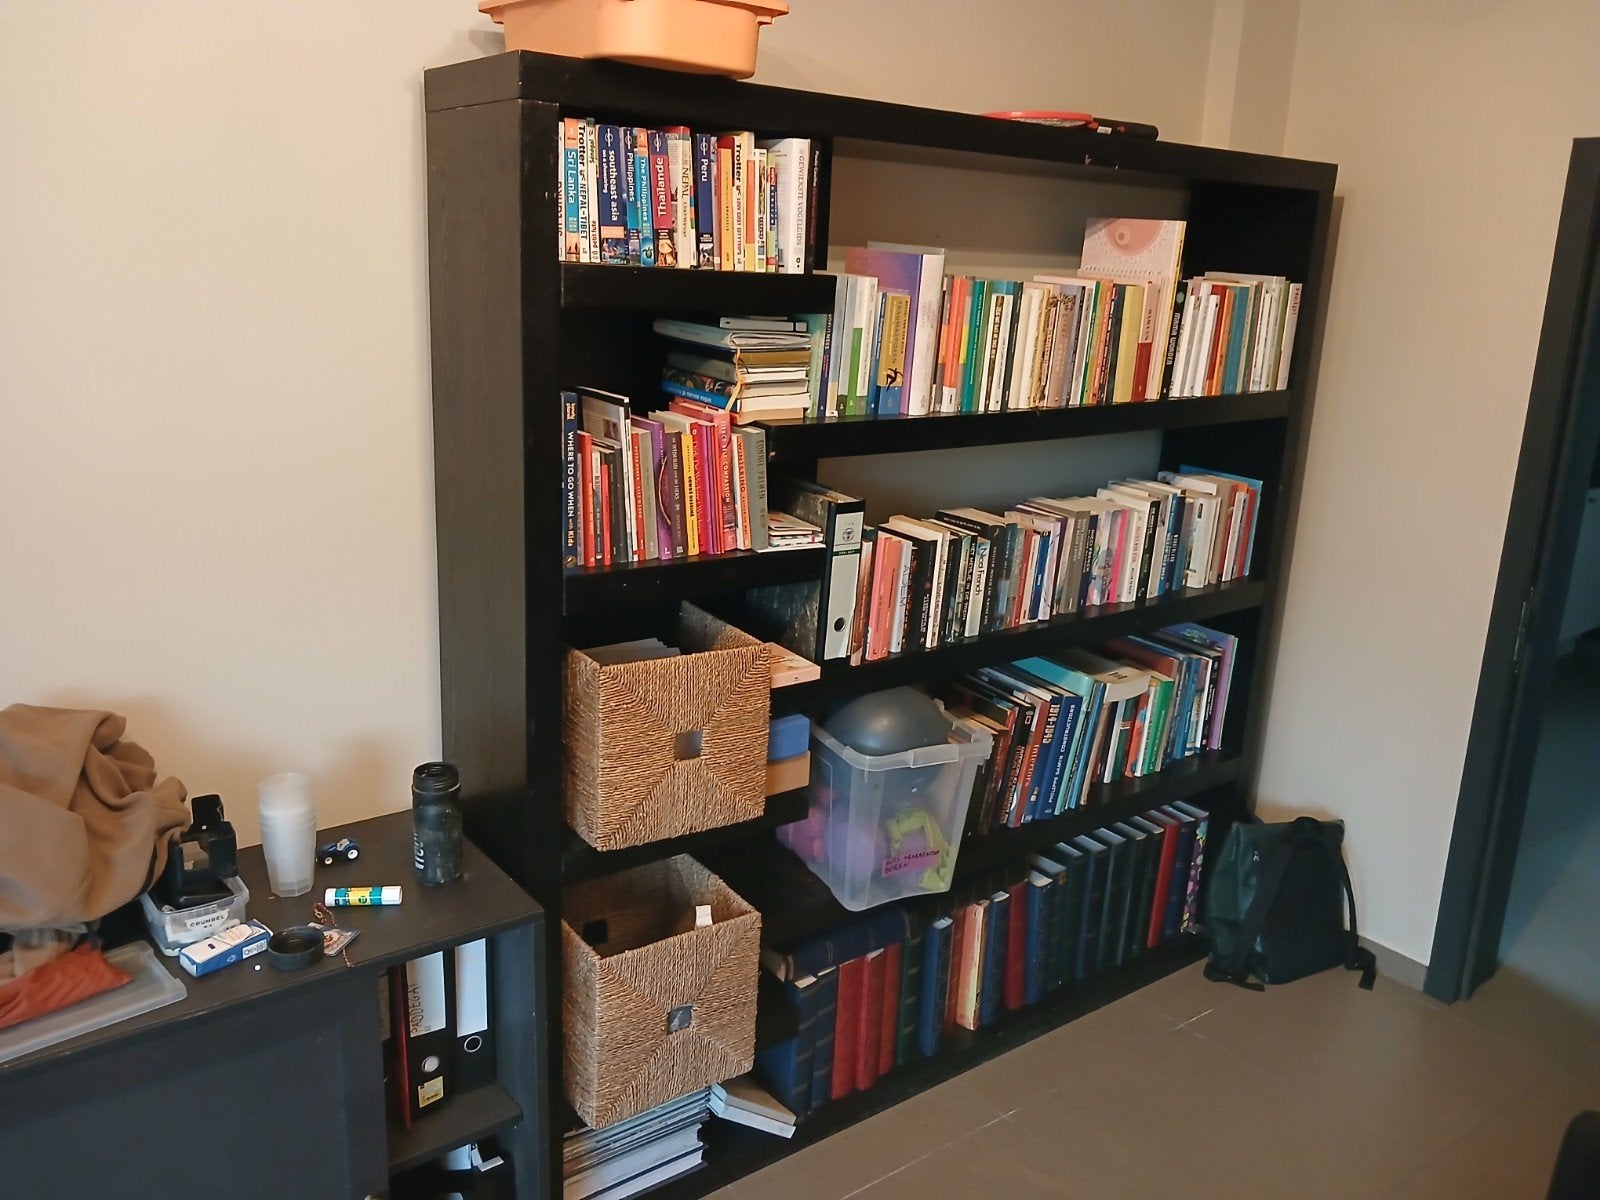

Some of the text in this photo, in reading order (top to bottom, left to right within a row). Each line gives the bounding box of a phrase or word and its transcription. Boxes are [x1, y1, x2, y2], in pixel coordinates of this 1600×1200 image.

[578, 125, 587, 167] Trotter
[567, 151, 578, 204] Sri Lanka
[608, 149, 620, 221] southeast asia
[627, 152, 636, 202] Philippines
[681, 167, 689, 199] NEPAL
[701, 158, 709, 182] Peru
[640, 175, 649, 222] Philippines
[891, 300, 903, 364] TRAUMASPOREN
[567, 431, 575, 462] WHERE
[756, 439, 765, 467] CONNIE
[567, 463, 575, 475] TO
[567, 476, 575, 490] GO
[737, 442, 746, 493] WINTERING
[757, 470, 766, 500] PALMEN
[567, 491, 575, 517] WHEN
[567, 530, 575, 547] Kids
[1085, 547, 1094, 572] FRENCH
[899, 565, 910, 607] ADEM
[975, 570, 986, 596] French
[1042, 703, 1061, 745] 1914-1945
[1060, 704, 1075, 754] CONSTRUCTIONS
[1025, 743, 1040, 787] Interiors
